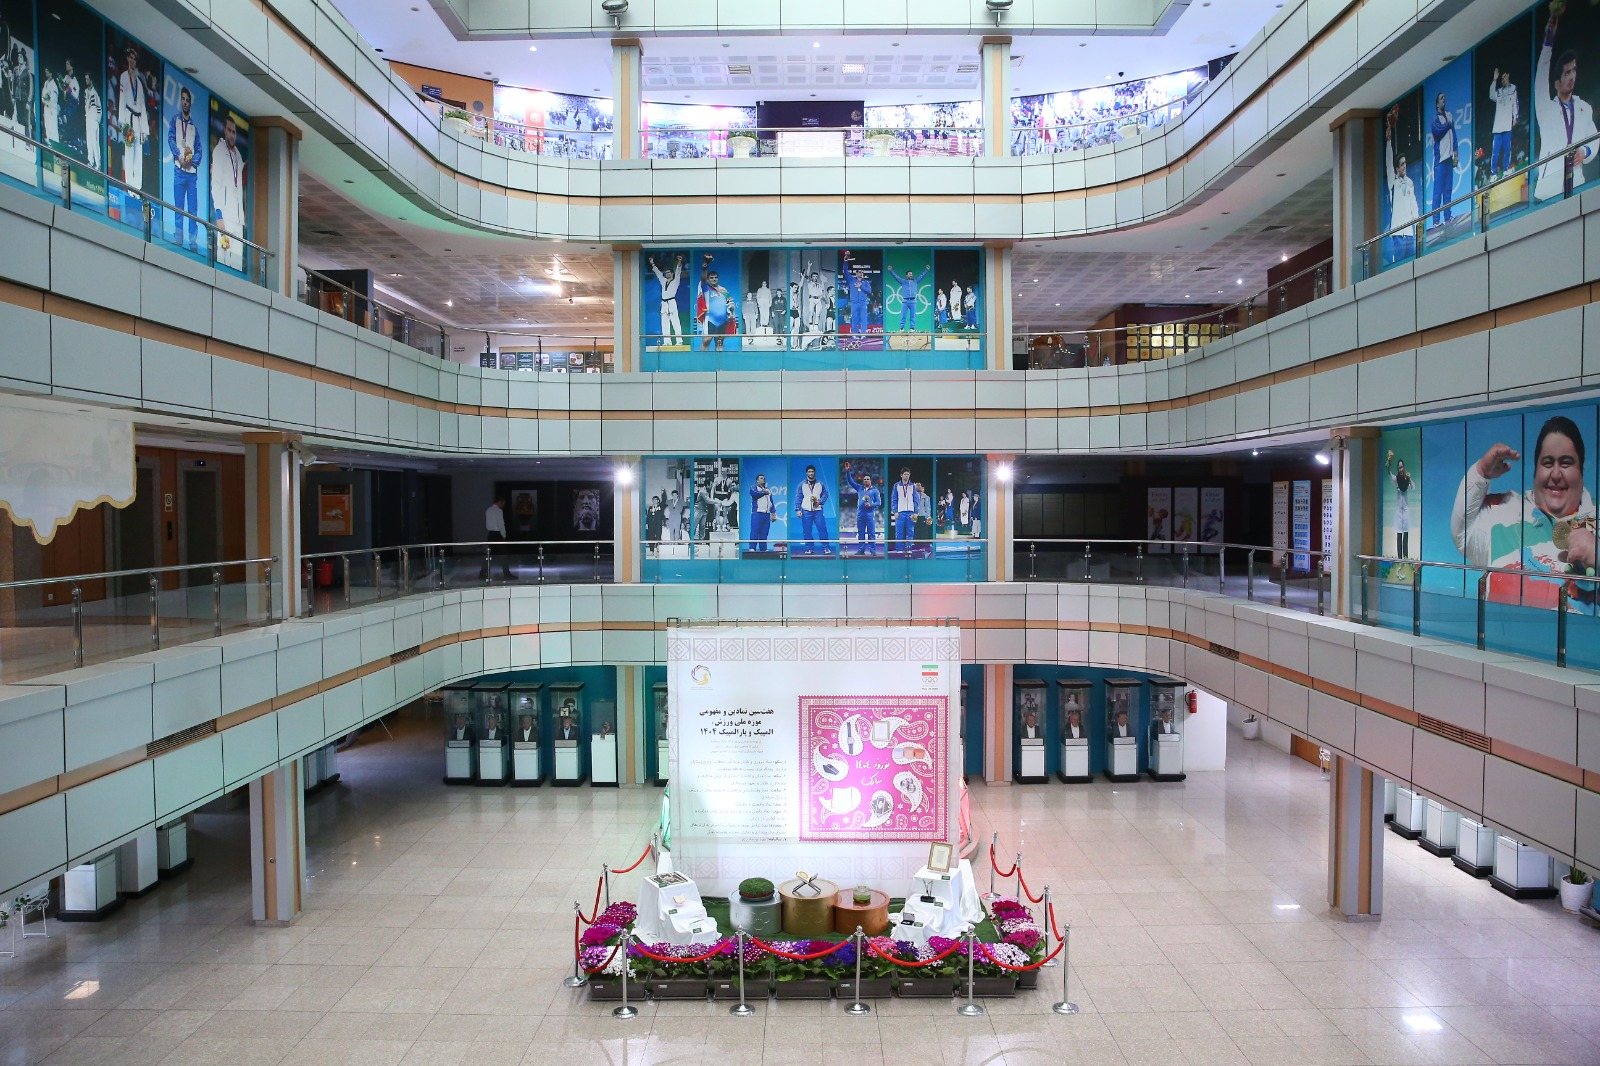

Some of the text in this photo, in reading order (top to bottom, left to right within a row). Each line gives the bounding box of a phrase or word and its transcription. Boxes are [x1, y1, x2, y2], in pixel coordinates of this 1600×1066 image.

[699, 707, 721, 717] مفهومی
[728, 707, 748, 717] نمادین
[734, 718, 747, 727] ملی
[747, 719, 762, 727] موزه
[700, 727, 717, 735] ۱۴۰۴
[753, 728, 774, 737] المپیک
[873, 757, 891, 770] نوروز
[860, 770, 883, 789] مبارک
